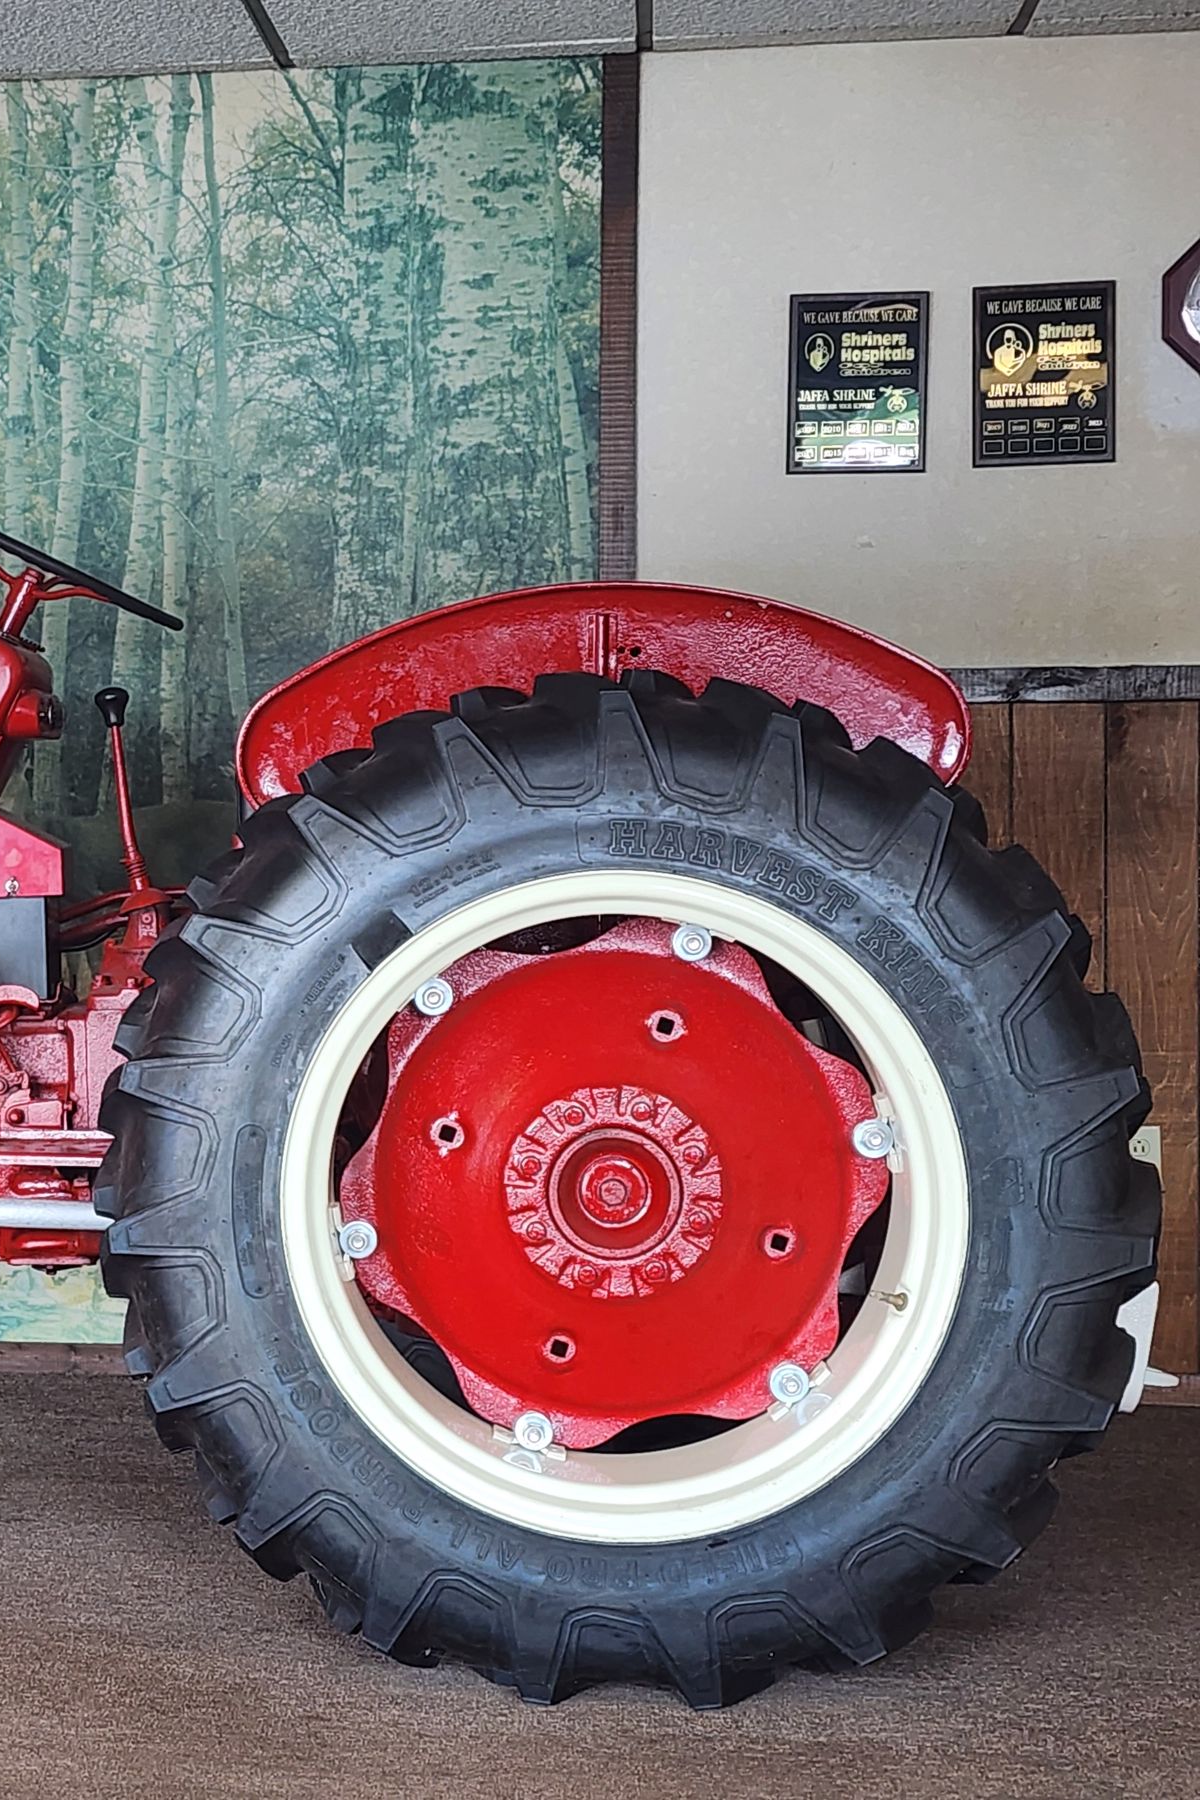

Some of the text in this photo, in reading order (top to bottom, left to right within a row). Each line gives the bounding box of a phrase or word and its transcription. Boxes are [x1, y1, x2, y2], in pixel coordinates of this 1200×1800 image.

[986, 296, 1102, 315] WE GAVE BECAUSE WE CARE
[803, 308, 919, 324] WE GAVE BECAUSE WE CARE
[841, 331, 907, 347] Shriners
[1038, 321, 1096, 339] Shriners
[840, 346, 915, 364] Hospitals
[1037, 338, 1102, 357] Hospitals
[797, 388, 877, 402] JAFFA SHRINE
[987, 381, 1068, 398] JAFFA SHRINE
[609, 819, 858, 922] HARVEST
[273, 1356, 434, 1527] PURPOSE
[450, 1517, 527, 1572] ALL
